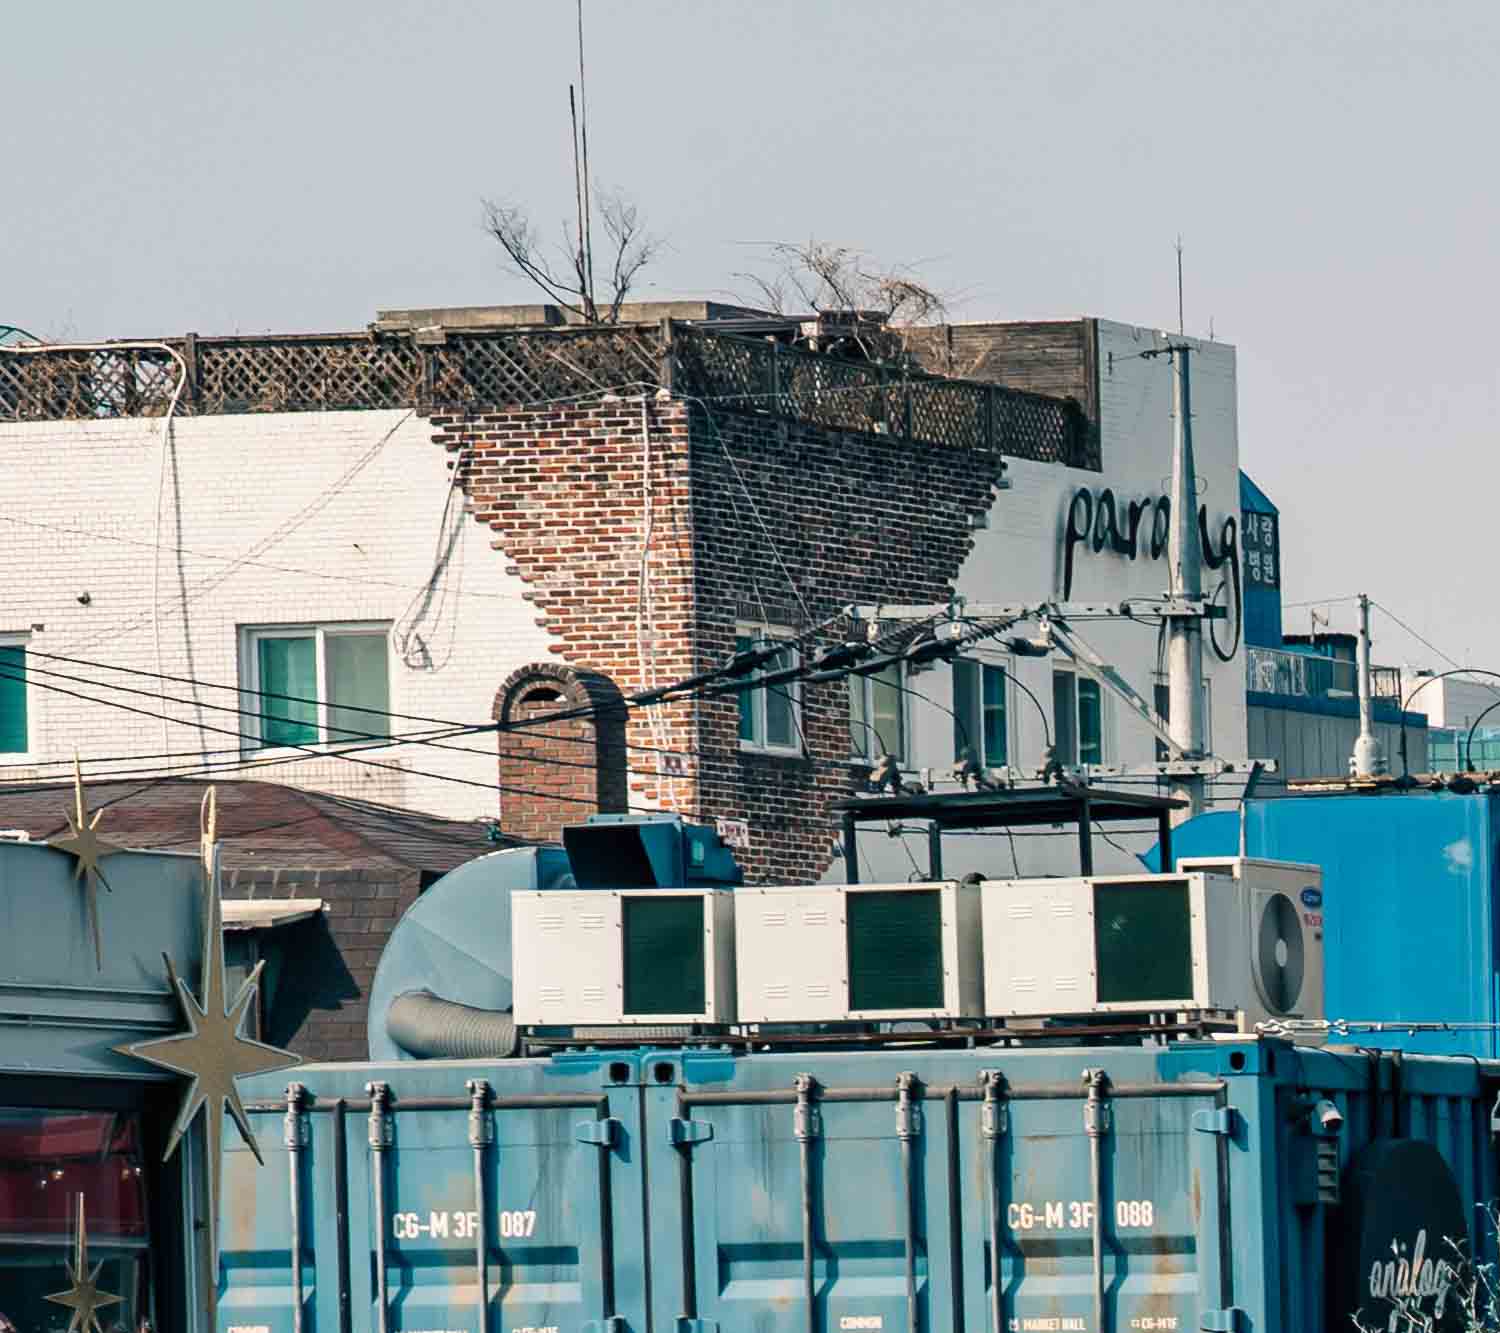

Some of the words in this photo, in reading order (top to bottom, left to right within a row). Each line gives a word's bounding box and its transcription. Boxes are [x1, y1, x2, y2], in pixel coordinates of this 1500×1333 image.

[500, 1210, 537, 1237] 087
[1116, 1200, 1154, 1227] 088
[840, 1316, 882, 1330] COMMON
